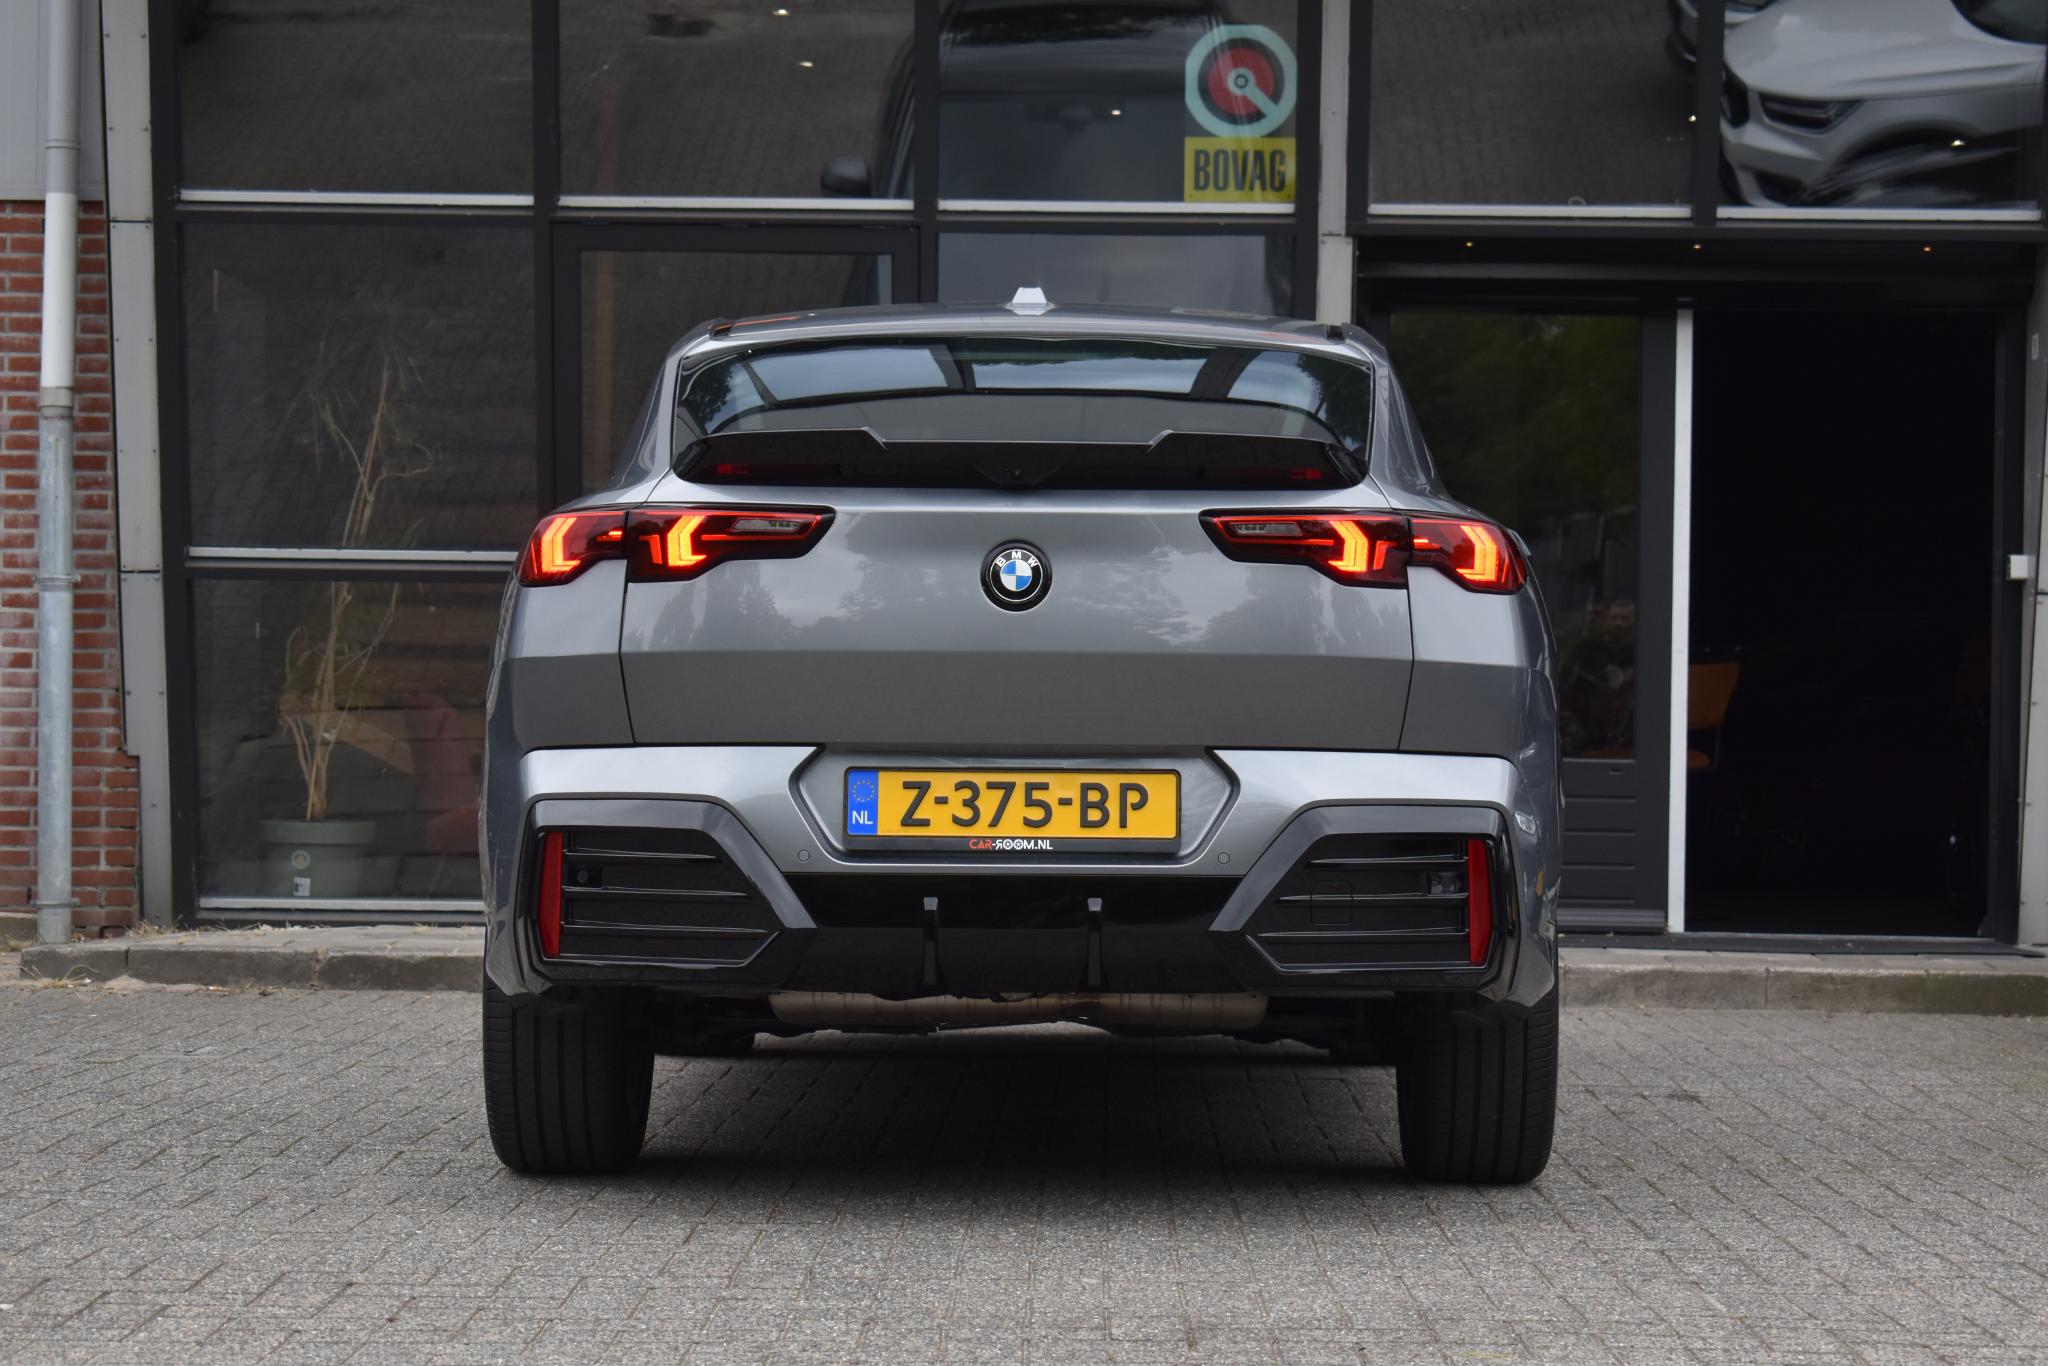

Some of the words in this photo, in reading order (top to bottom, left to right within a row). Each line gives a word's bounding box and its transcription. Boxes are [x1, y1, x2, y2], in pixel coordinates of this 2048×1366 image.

[1193, 148, 1287, 193] BOVAG
[995, 551, 1039, 568] BMW
[851, 811, 873, 825] NL
[899, 780, 1149, 829] Z-375-BP
